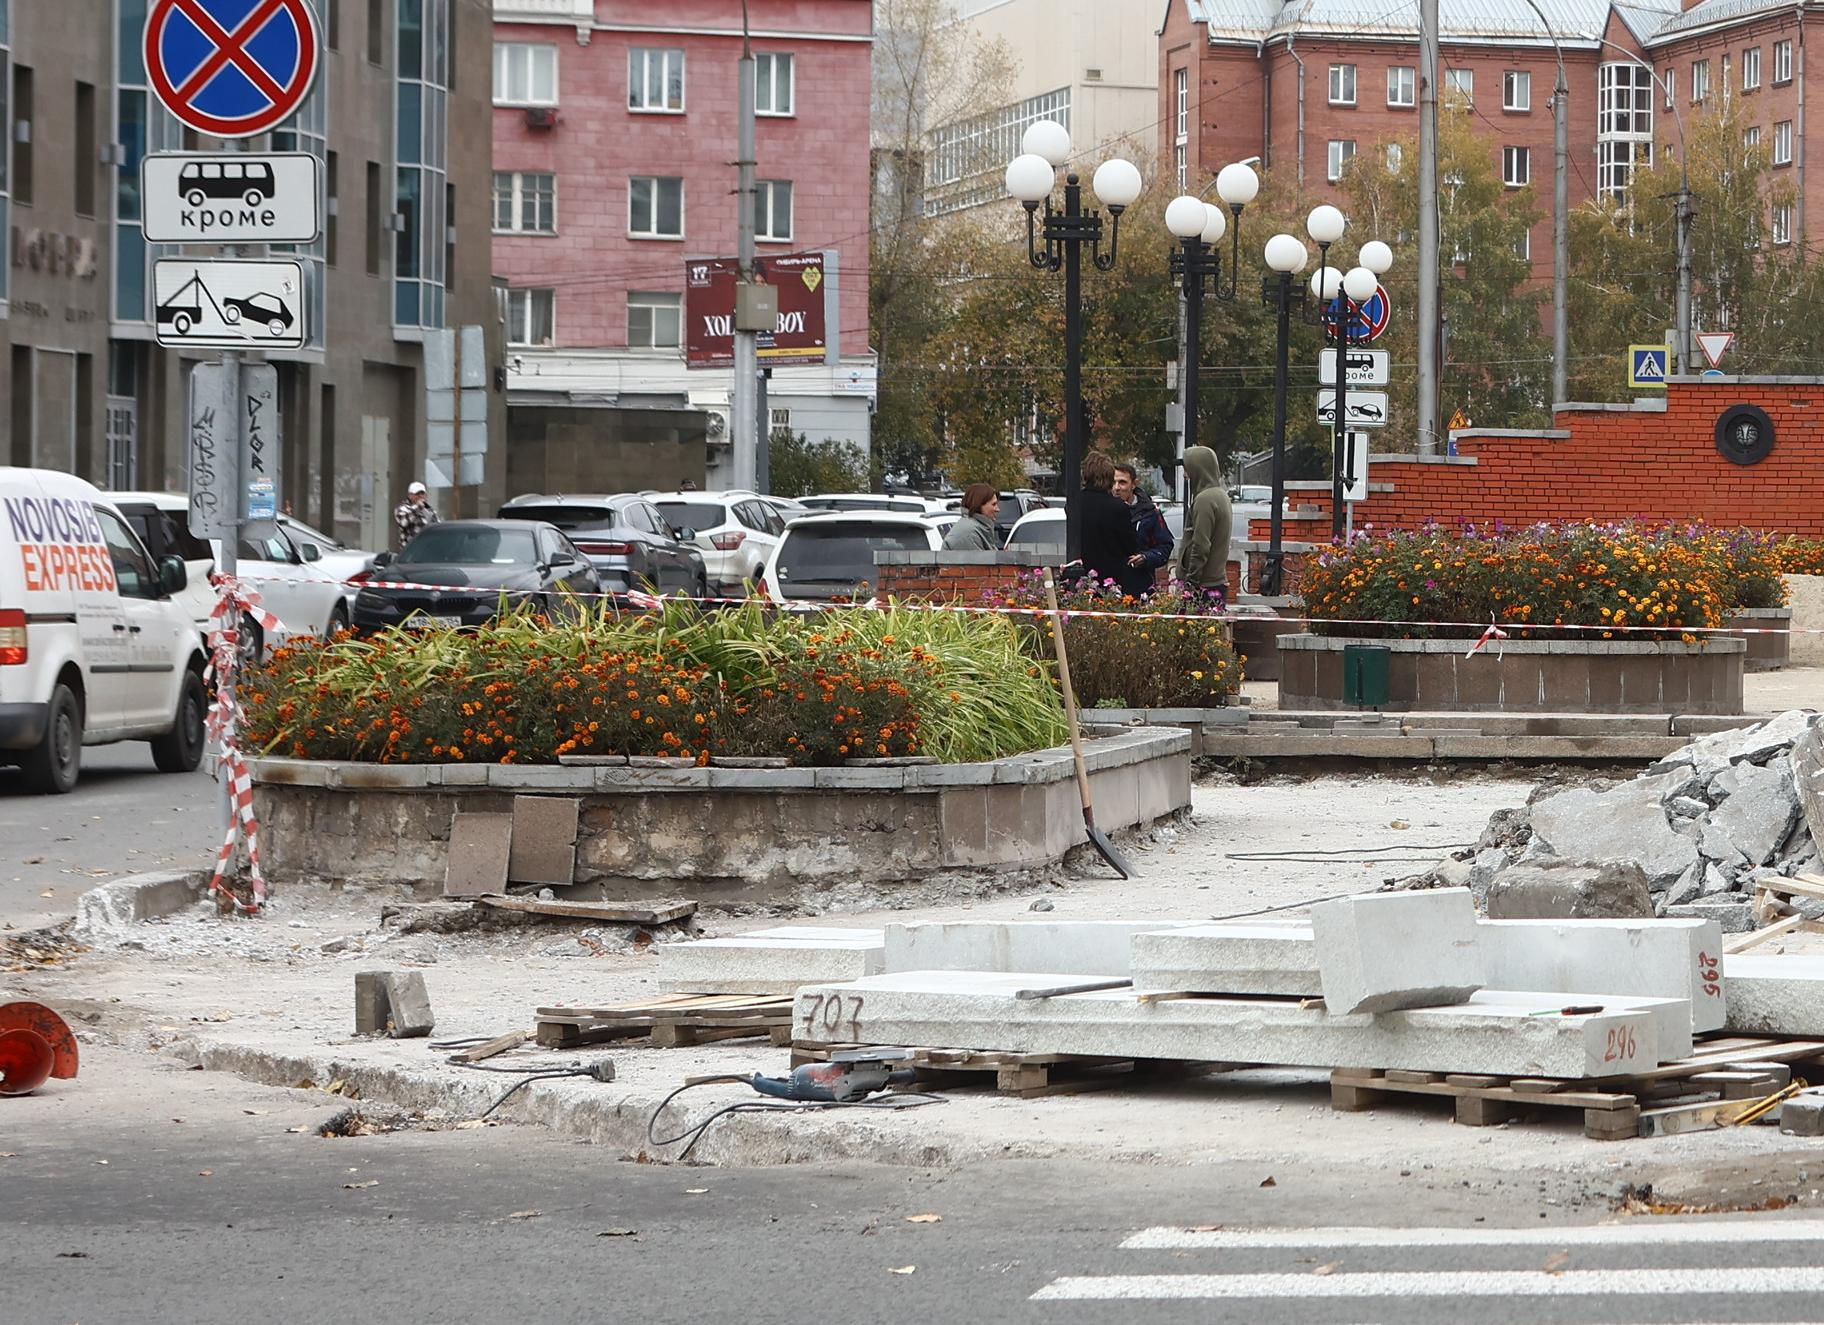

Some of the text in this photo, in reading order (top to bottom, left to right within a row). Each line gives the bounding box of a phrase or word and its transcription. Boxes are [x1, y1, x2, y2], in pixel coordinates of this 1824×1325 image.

[181, 210, 275, 233] кроме
[3, 497, 101, 543] NOVOSIB
[21, 544, 114, 591] EXPRESS
[802, 994, 864, 1040] 707
[1604, 1025, 1636, 1062] 296
